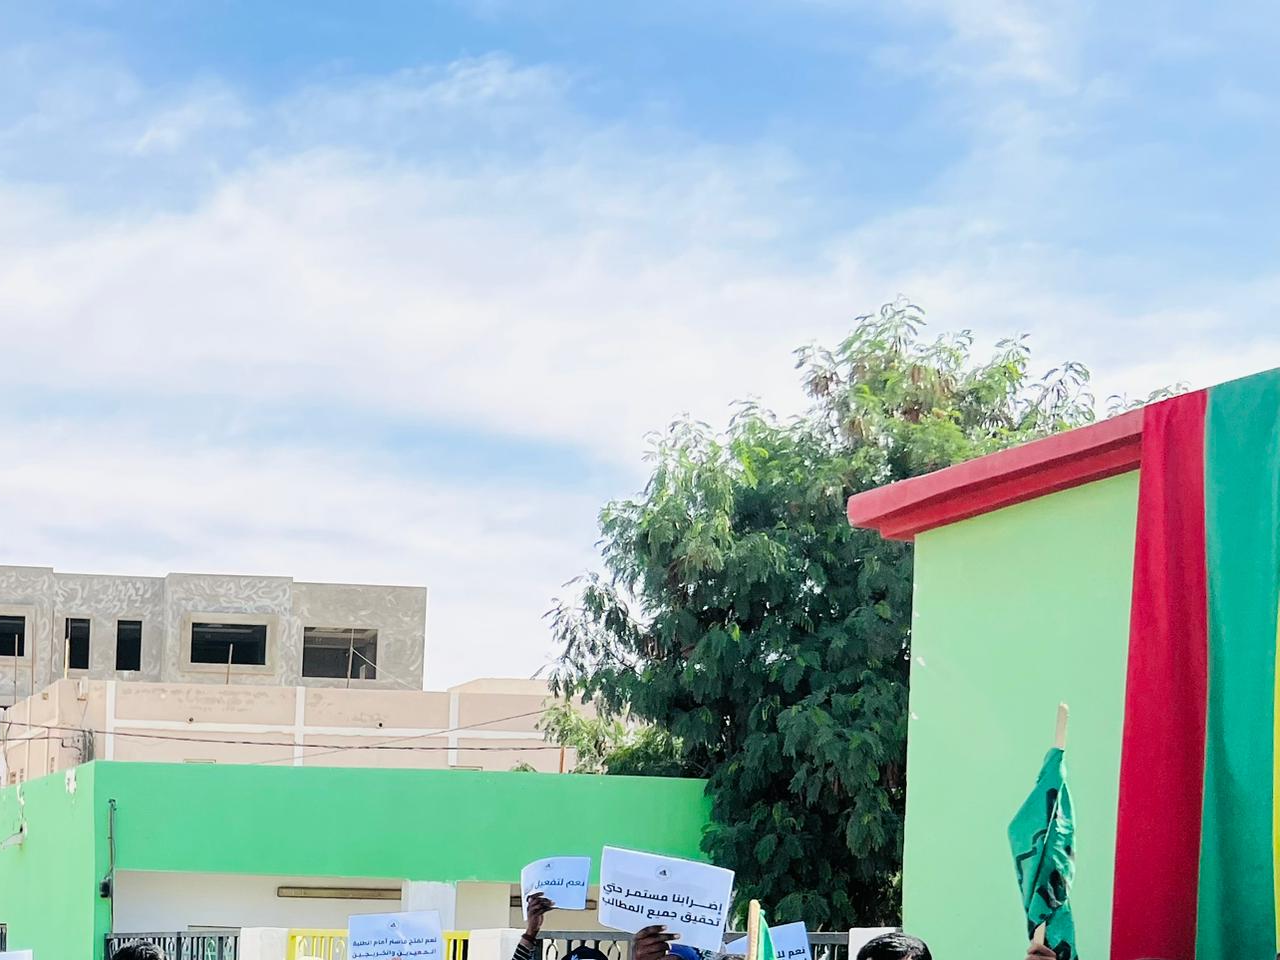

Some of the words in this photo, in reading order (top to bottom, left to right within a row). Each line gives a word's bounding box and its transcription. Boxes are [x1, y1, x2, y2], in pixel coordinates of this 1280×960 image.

[625, 888, 669, 903] مستمر
[602, 896, 644, 914] المطالب
[646, 908, 677, 919] جميع
[680, 912, 721, 927] تحقيق
[788, 947, 806, 959] نعم
